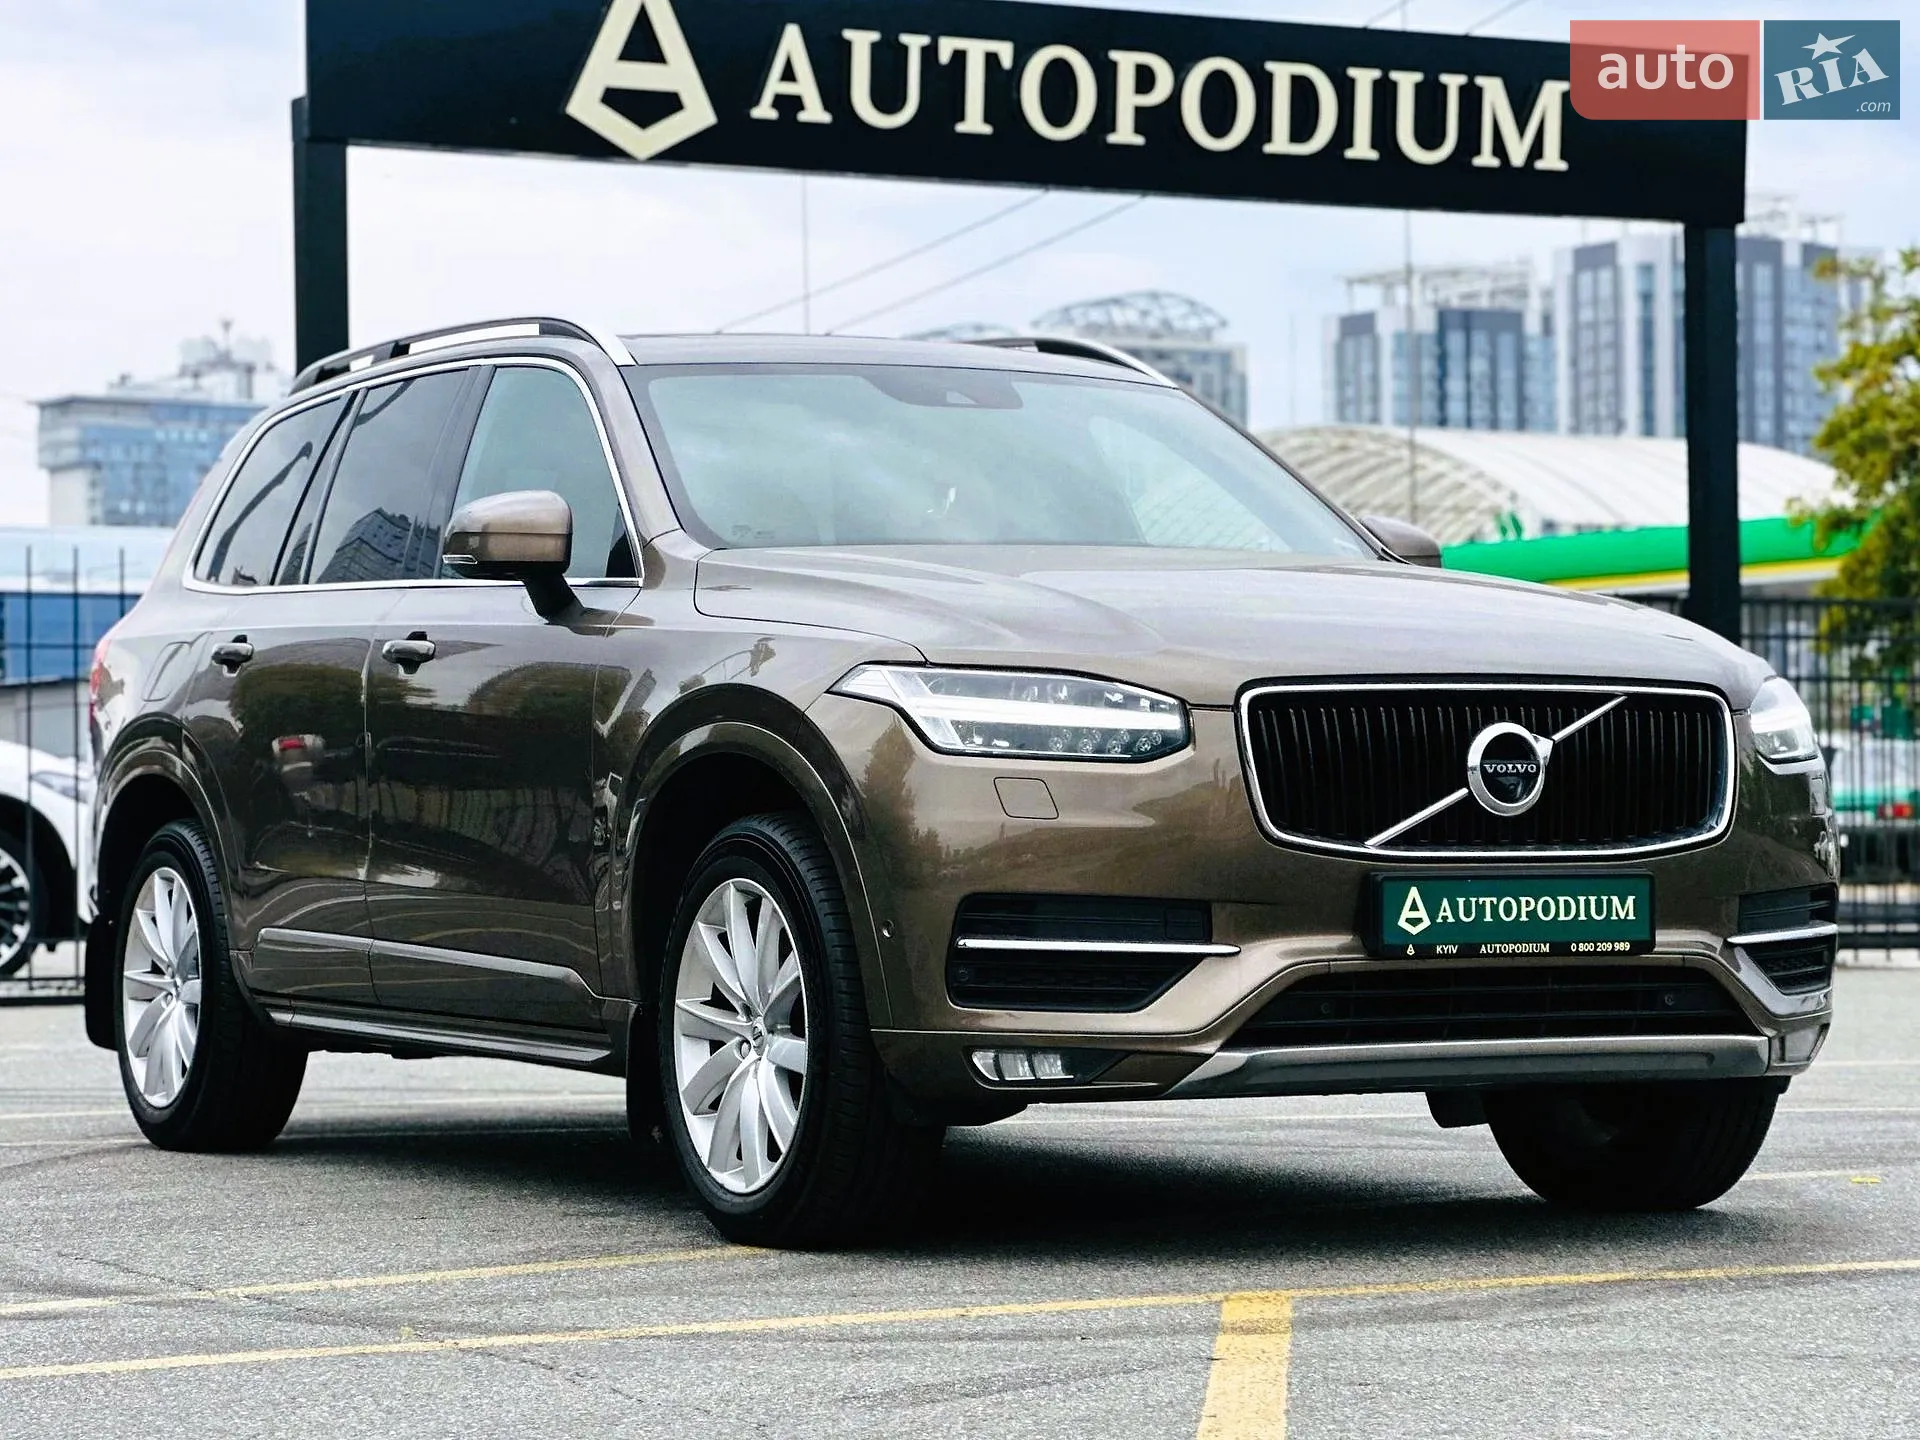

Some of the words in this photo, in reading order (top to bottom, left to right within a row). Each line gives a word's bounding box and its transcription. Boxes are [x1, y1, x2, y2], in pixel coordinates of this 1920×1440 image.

[749, 22, 1570, 172] AUTOPODIUM
[1483, 764, 1537, 773] VOLVO
[1436, 895, 1636, 923] AUTOPODIUM
[1436, 945, 1458, 954] KYIV
[1480, 943, 1550, 953] AUTOPODIUM
[1570, 943, 1577, 952] 0
[1578, 942, 1594, 952] 800
[1596, 942, 1612, 952] 209
[1614, 942, 1630, 951] 989
